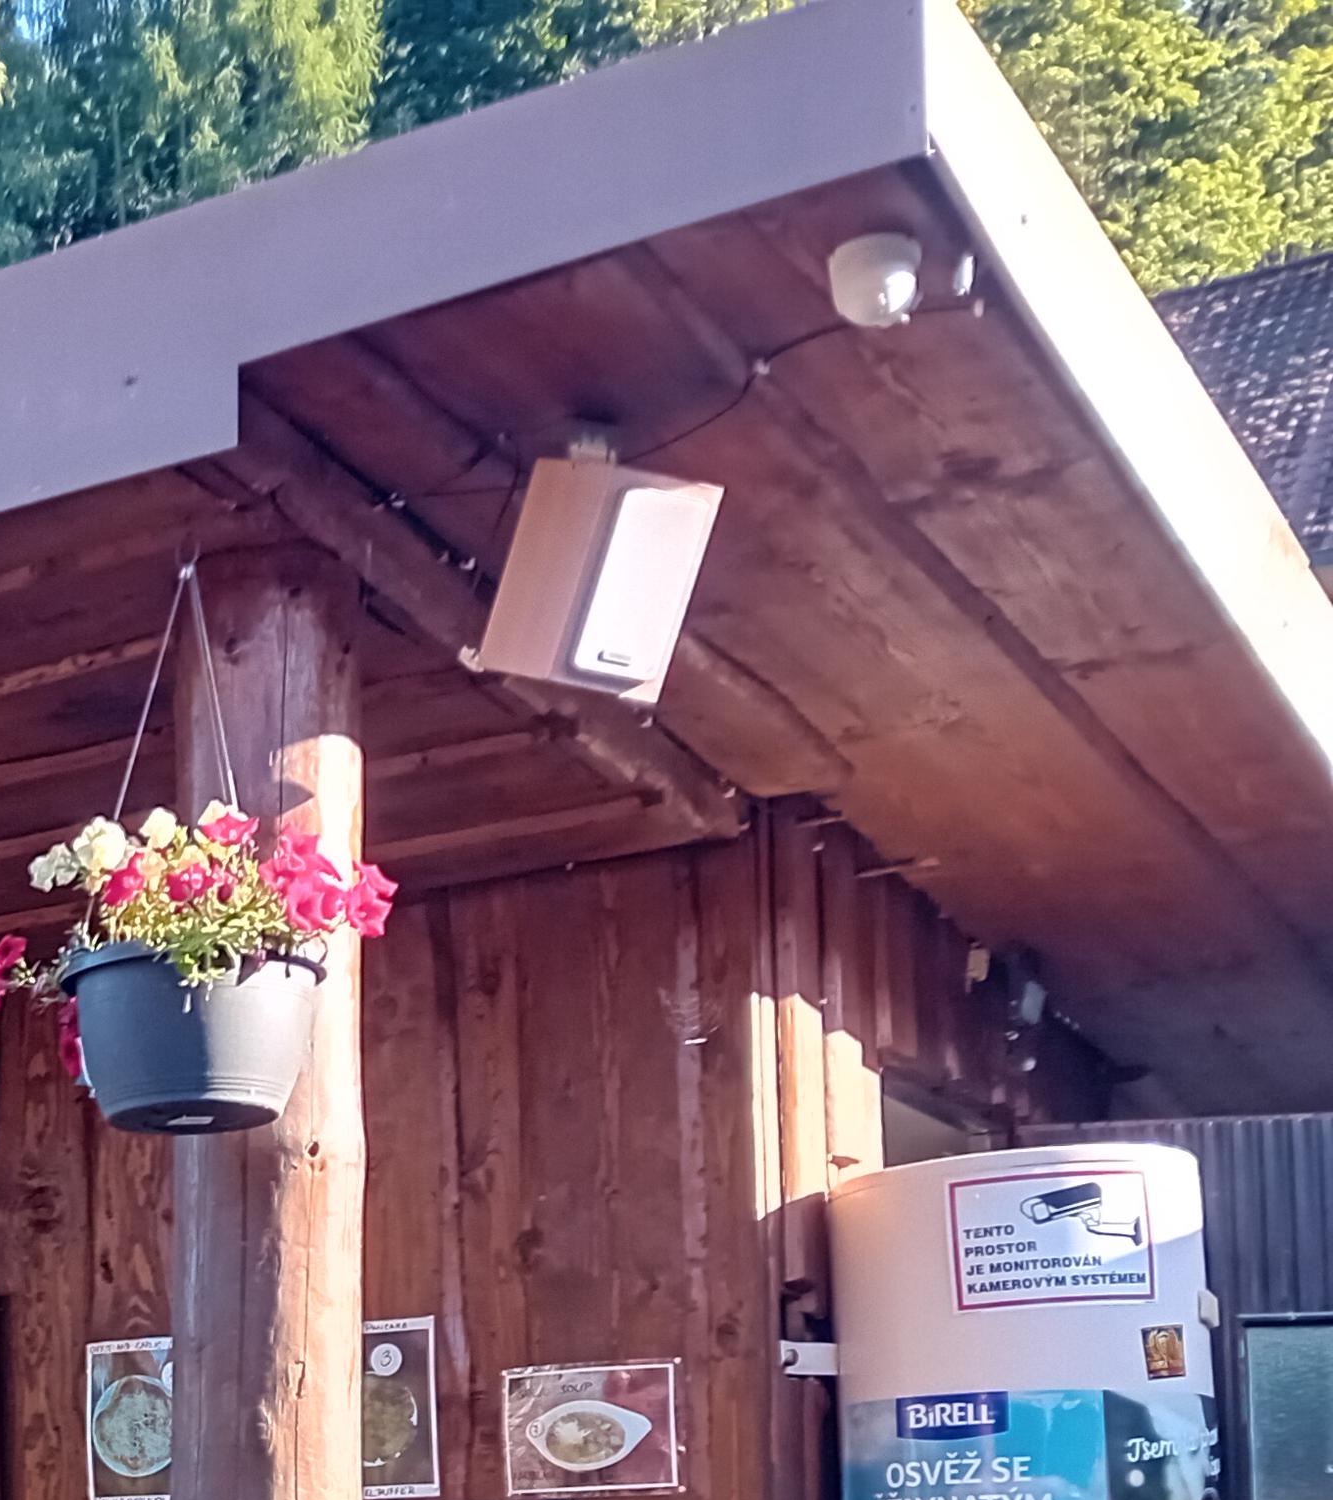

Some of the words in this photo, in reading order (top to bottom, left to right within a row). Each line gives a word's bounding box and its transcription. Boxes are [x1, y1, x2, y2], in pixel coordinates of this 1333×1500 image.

[963, 1225, 1015, 1240] TENTO
[964, 1241, 1037, 1257] PROSTOR
[966, 1264, 985, 1276] JE
[989, 1253, 1102, 1274] MONITOROVÁN
[967, 1273, 1067, 1294] KAMEROVÝM
[1071, 1271, 1146, 1287] SYSTÉMEM
[380, 1350, 392, 1367] 3
[561, 1381, 594, 1395] SOUP
[885, 1450, 982, 1489] OSVĚŽ
[991, 1456, 1032, 1484] SE
